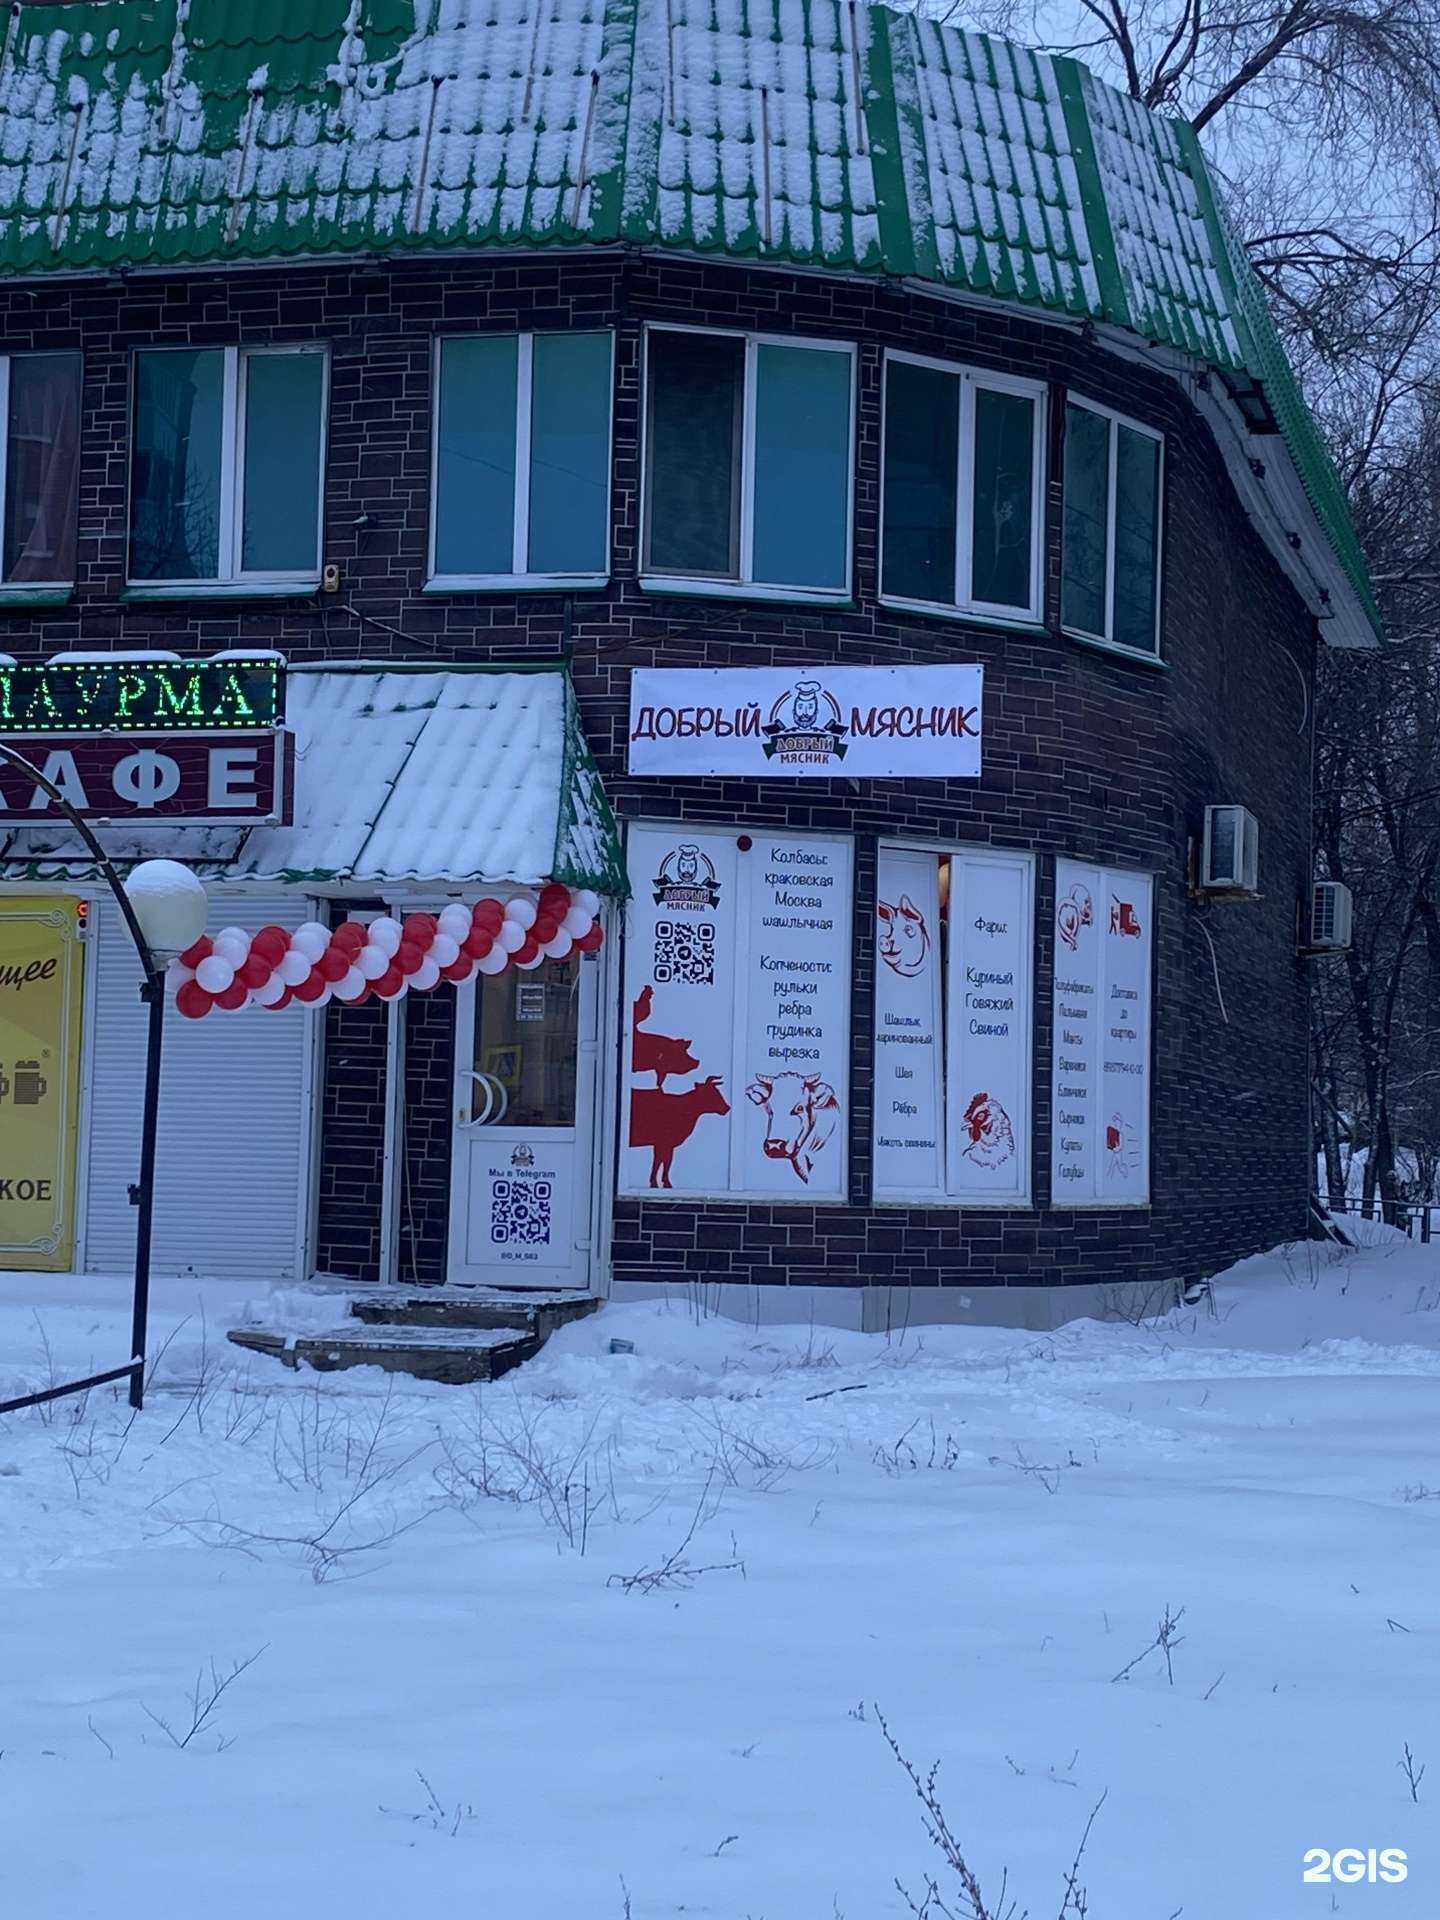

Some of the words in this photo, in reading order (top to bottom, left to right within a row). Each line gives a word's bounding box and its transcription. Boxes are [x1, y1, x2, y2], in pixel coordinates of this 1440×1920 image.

[0, 674, 254, 718] АУРМА
[631, 702, 761, 741] ДОБРЫЙ
[851, 706, 980, 738] МЯСНИК
[776, 736, 834, 751] ДОБРЫЙ
[780, 752, 830, 764] МЯСНИК
[0, 748, 259, 809] АФЕ
[771, 848, 828, 865] Колбасы:
[765, 873, 833, 888] краковская
[775, 891, 822, 908] Москва
[763, 917, 833, 930] шашлычная
[760, 955, 832, 973] Копчености:
[966, 966, 1013, 989] Куриный
[774, 981, 818, 997] рульки
[778, 1000, 812, 1019] ребра
[965, 992, 1014, 1010] Говяжий
[766, 1025, 823, 1040] грудинка
[969, 1018, 1009, 1036] Свиной
[768, 1047, 820, 1063] вырезка
[894, 1066, 914, 1079] Шея
[488, 1168, 505, 1177] Мы
[516, 1169, 556, 1180] Telegram
